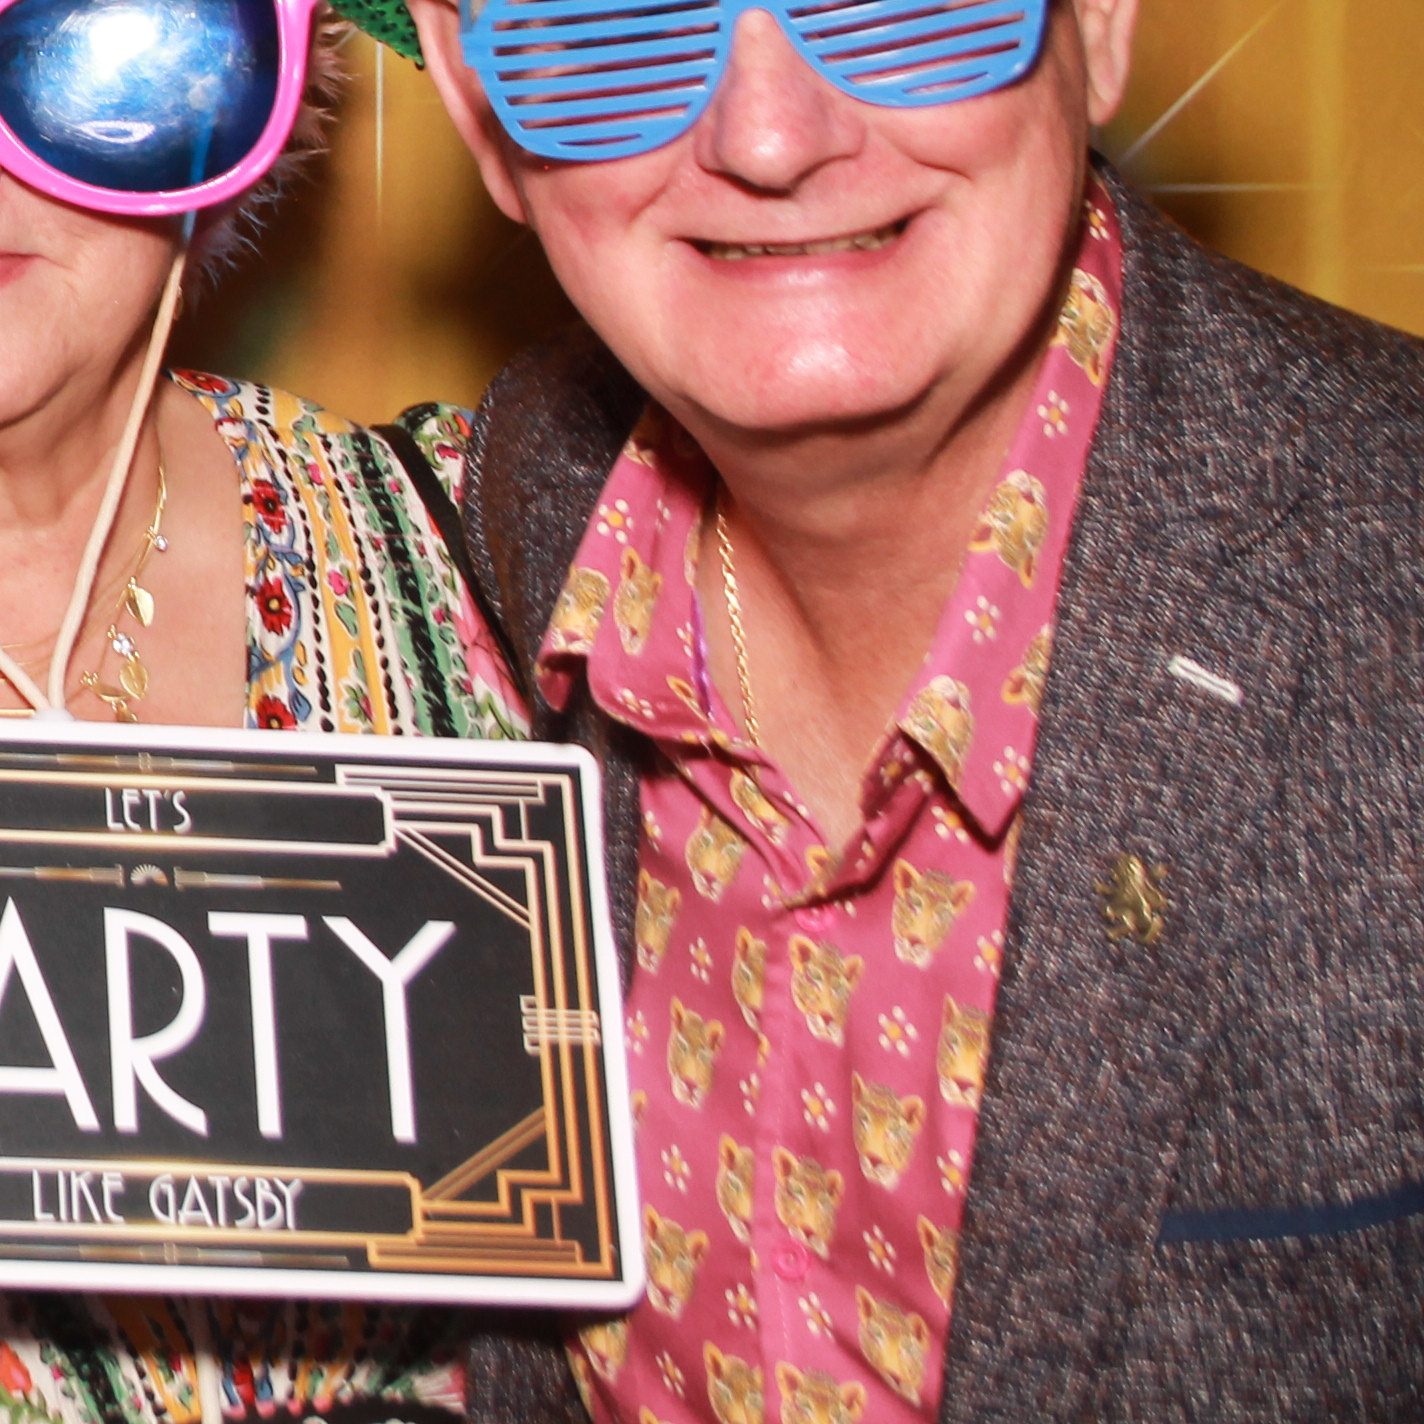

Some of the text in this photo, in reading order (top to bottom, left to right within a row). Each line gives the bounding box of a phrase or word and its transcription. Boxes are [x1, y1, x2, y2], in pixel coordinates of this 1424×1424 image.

[103, 786, 193, 833] LET'S
[31, 1168, 306, 1232] LIKE GATSBY
